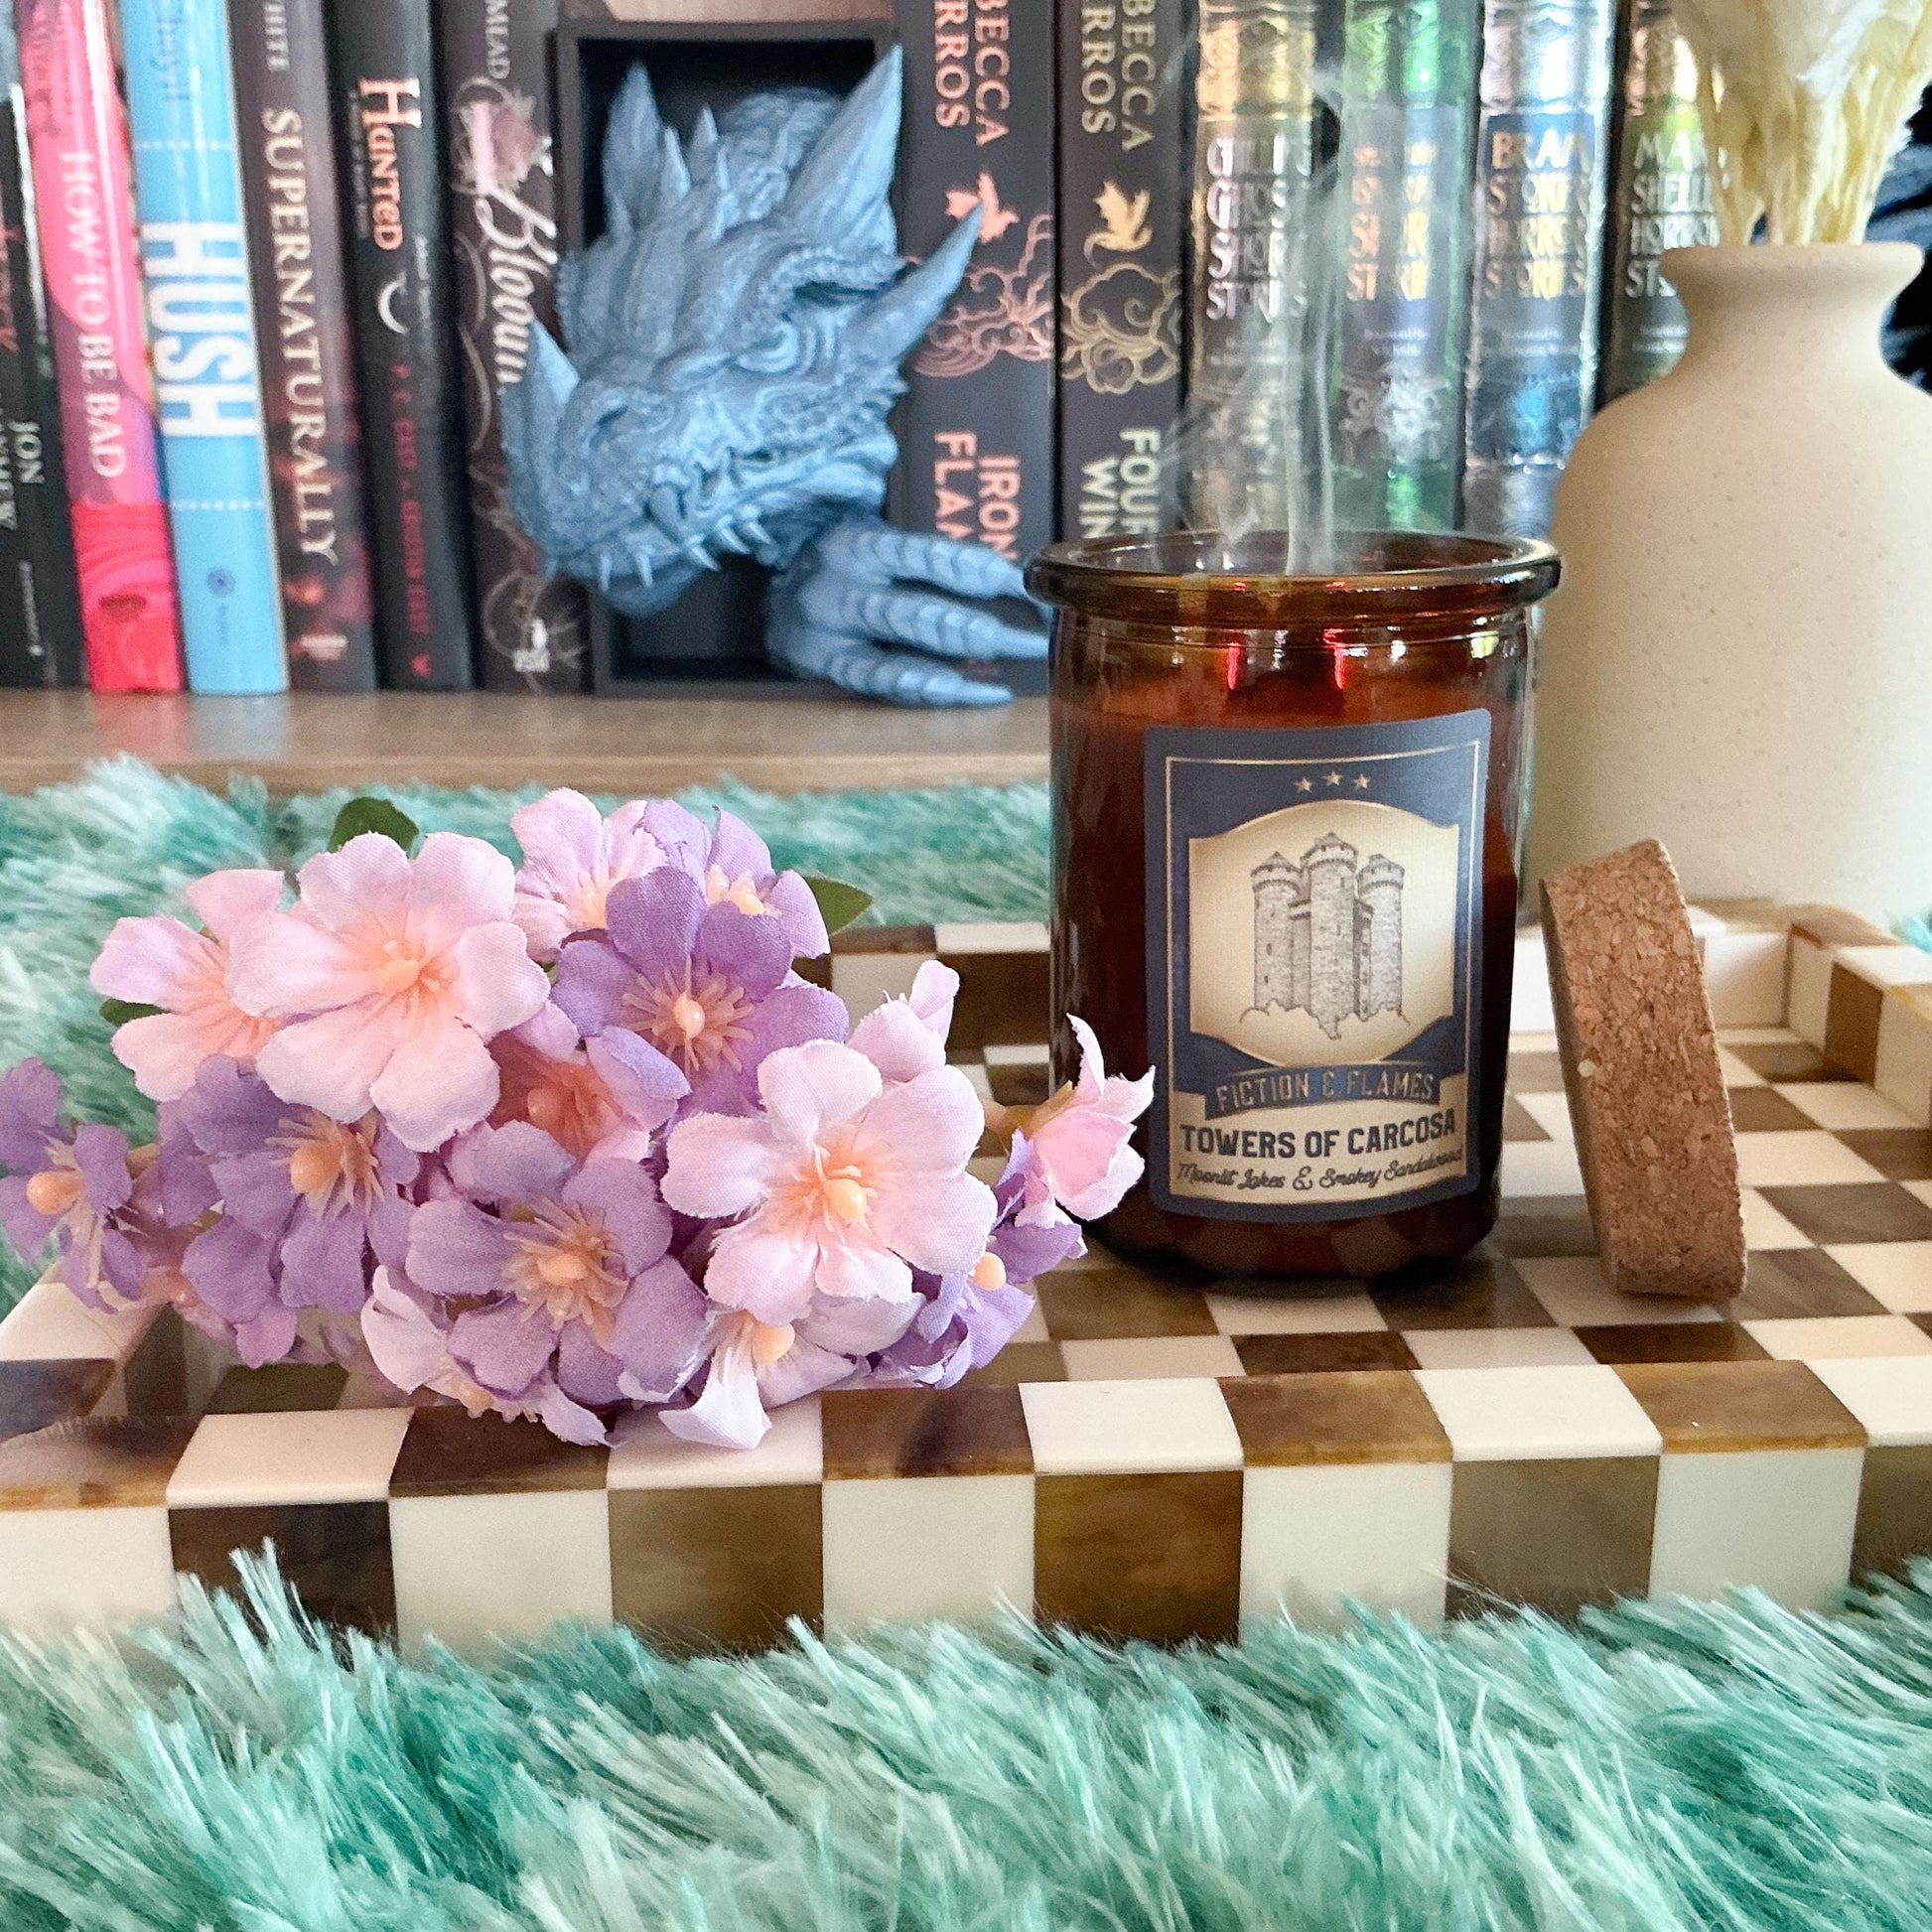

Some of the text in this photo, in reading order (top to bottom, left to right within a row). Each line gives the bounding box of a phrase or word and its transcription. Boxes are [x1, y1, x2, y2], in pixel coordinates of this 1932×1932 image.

[59, 151, 128, 478] HOW TO BE BAD
[141, 222, 260, 437] HUSH
[261, 107, 340, 566] SUPERNATURALLY
[8, 420, 46, 484] JON
[1215, 1072, 1309, 1111] FICTION
[1346, 1069, 1434, 1099] FLAMES
[1179, 1108, 1455, 1159] TOWERS OF CARCOSA
[1176, 1163, 1239, 1185] Moonlit
[1237, 1169, 1286, 1189] Lakes
[1293, 1166, 1312, 1190] &
